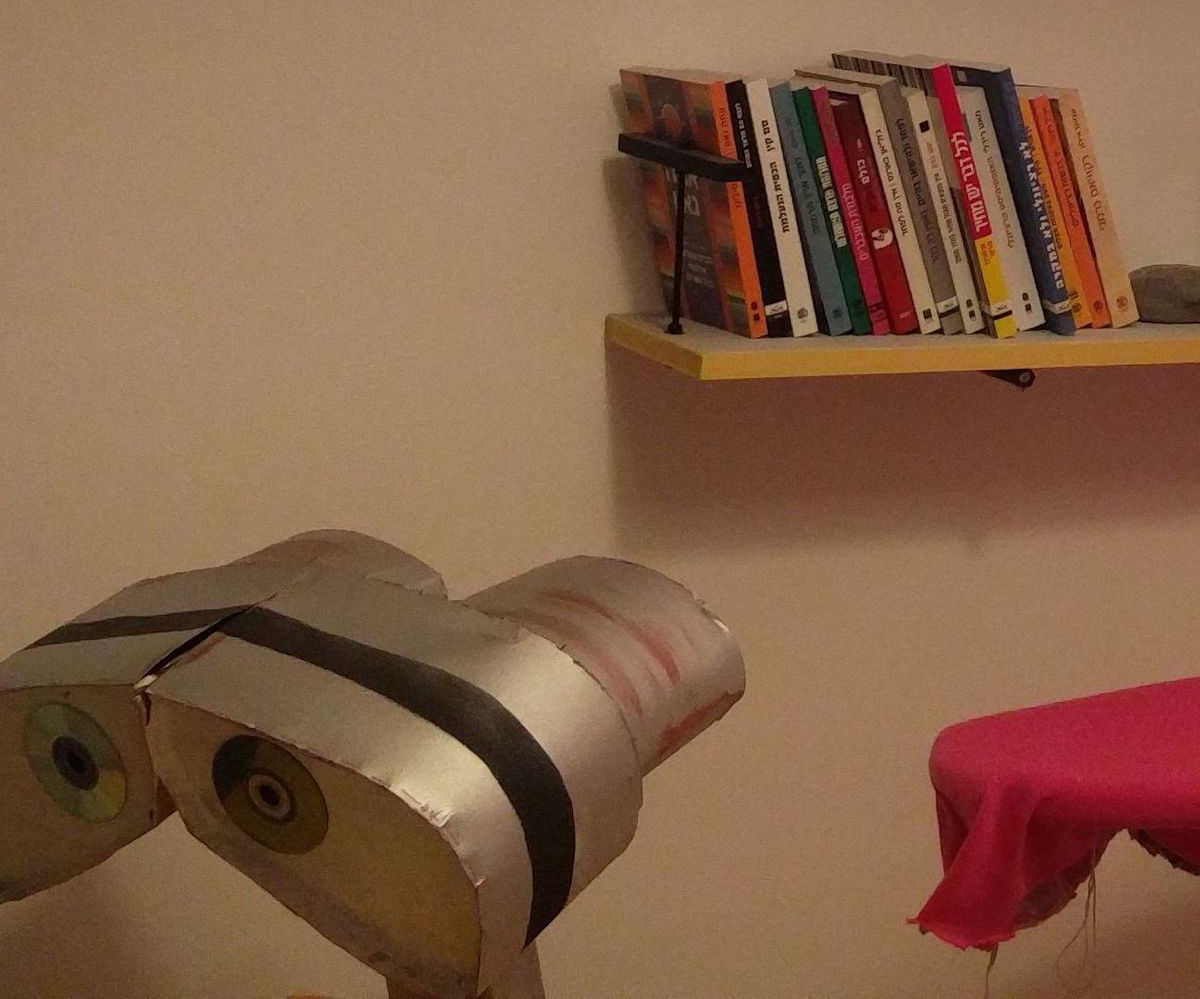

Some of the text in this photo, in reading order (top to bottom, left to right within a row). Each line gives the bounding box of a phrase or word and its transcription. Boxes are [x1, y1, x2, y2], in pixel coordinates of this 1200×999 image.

[894, 117, 909, 141] לפחד
[973, 109, 985, 128] מאט
[948, 130, 970, 156] לכל
[1018, 140, 1032, 159] לא
[760, 118, 791, 233] סם קין הכפית הנעלמת
[855, 157, 871, 184] כולם
[958, 156, 976, 181] דבר
[1079, 153, 1101, 198] רקוויאם
[963, 181, 981, 199] יש
[1024, 162, 1045, 212] רציונלי
[890, 186, 901, 200] אין
[896, 214, 909, 236] לפחד
[968, 199, 990, 232] מחיר
[850, 217, 869, 260] העכברים
[1037, 215, 1051, 239] ולא
[1045, 241, 1064, 288] במקרה
